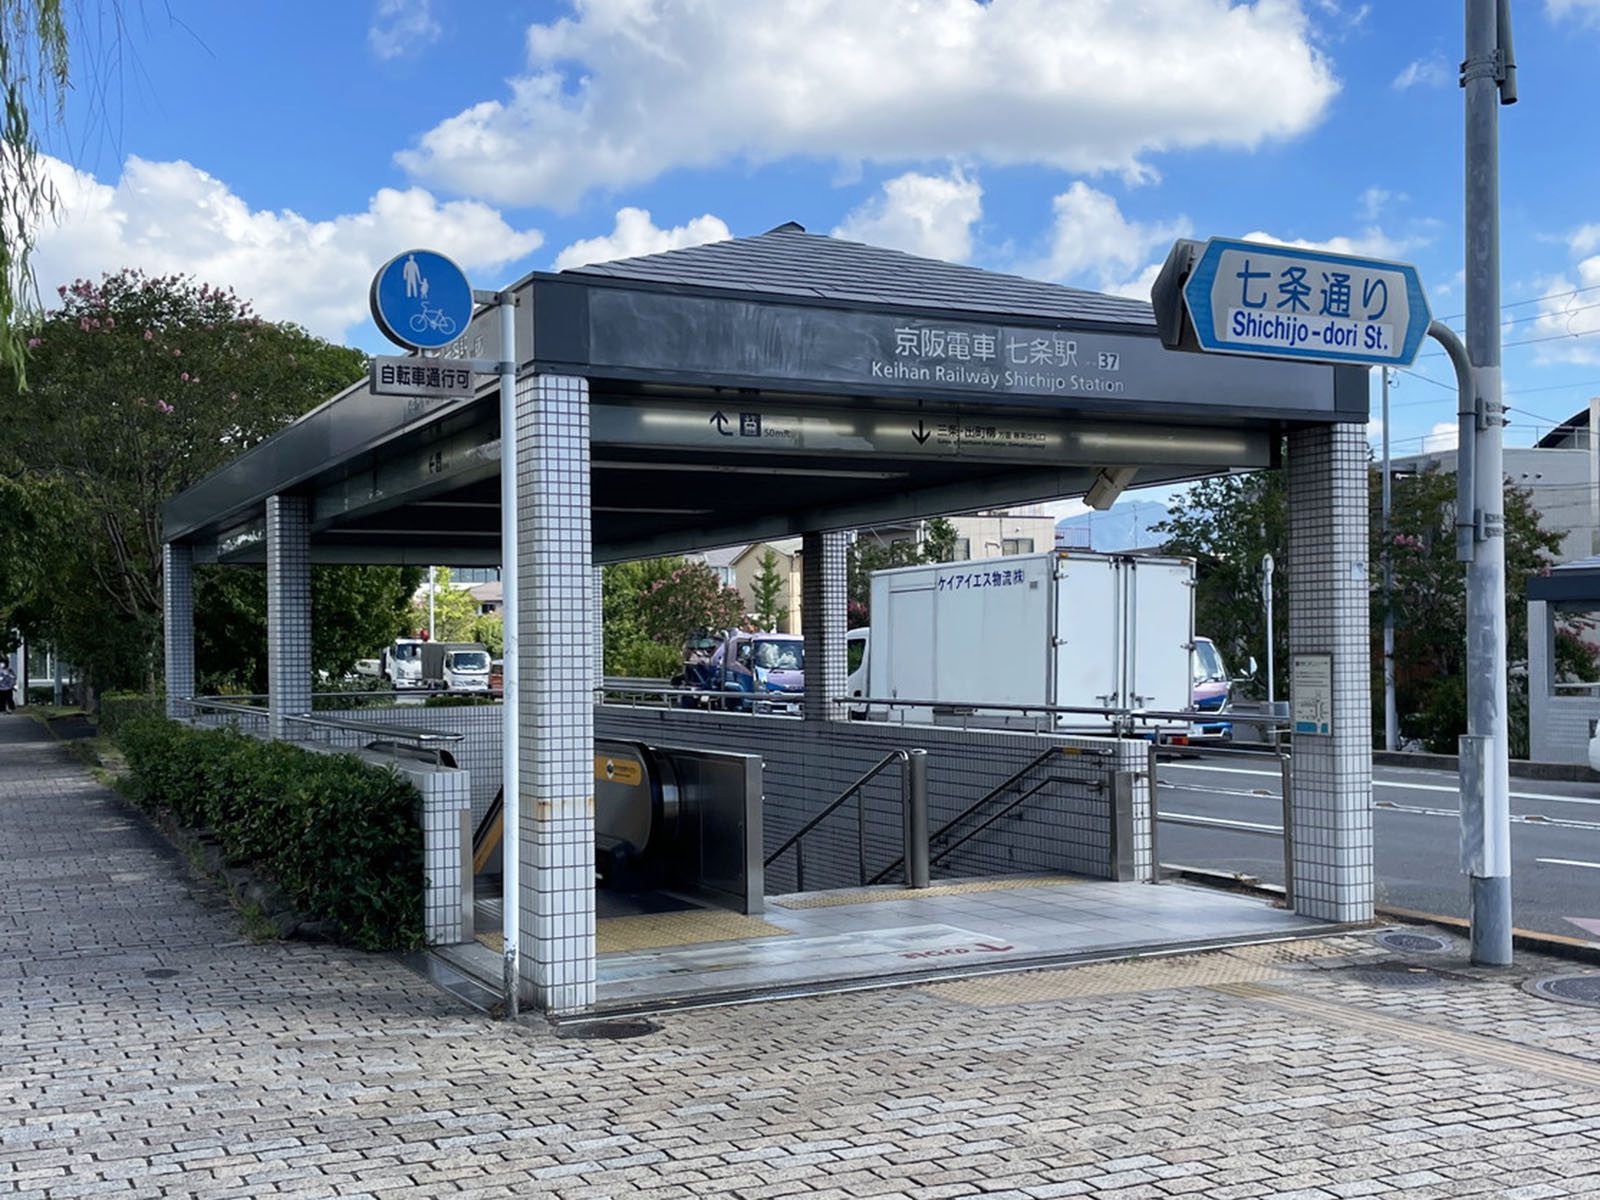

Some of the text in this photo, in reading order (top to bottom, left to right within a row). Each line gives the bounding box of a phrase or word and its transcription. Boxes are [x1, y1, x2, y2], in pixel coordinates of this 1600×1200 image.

[1236, 259, 1388, 321] 七条通り
[894, 327, 1118, 370] 京阪電車 七条駅 37
[1363, 323, 1389, 350] St.
[381, 365, 471, 389] 自転車通行可
[871, 361, 1124, 392] Keihan Railway Shichijo Station
